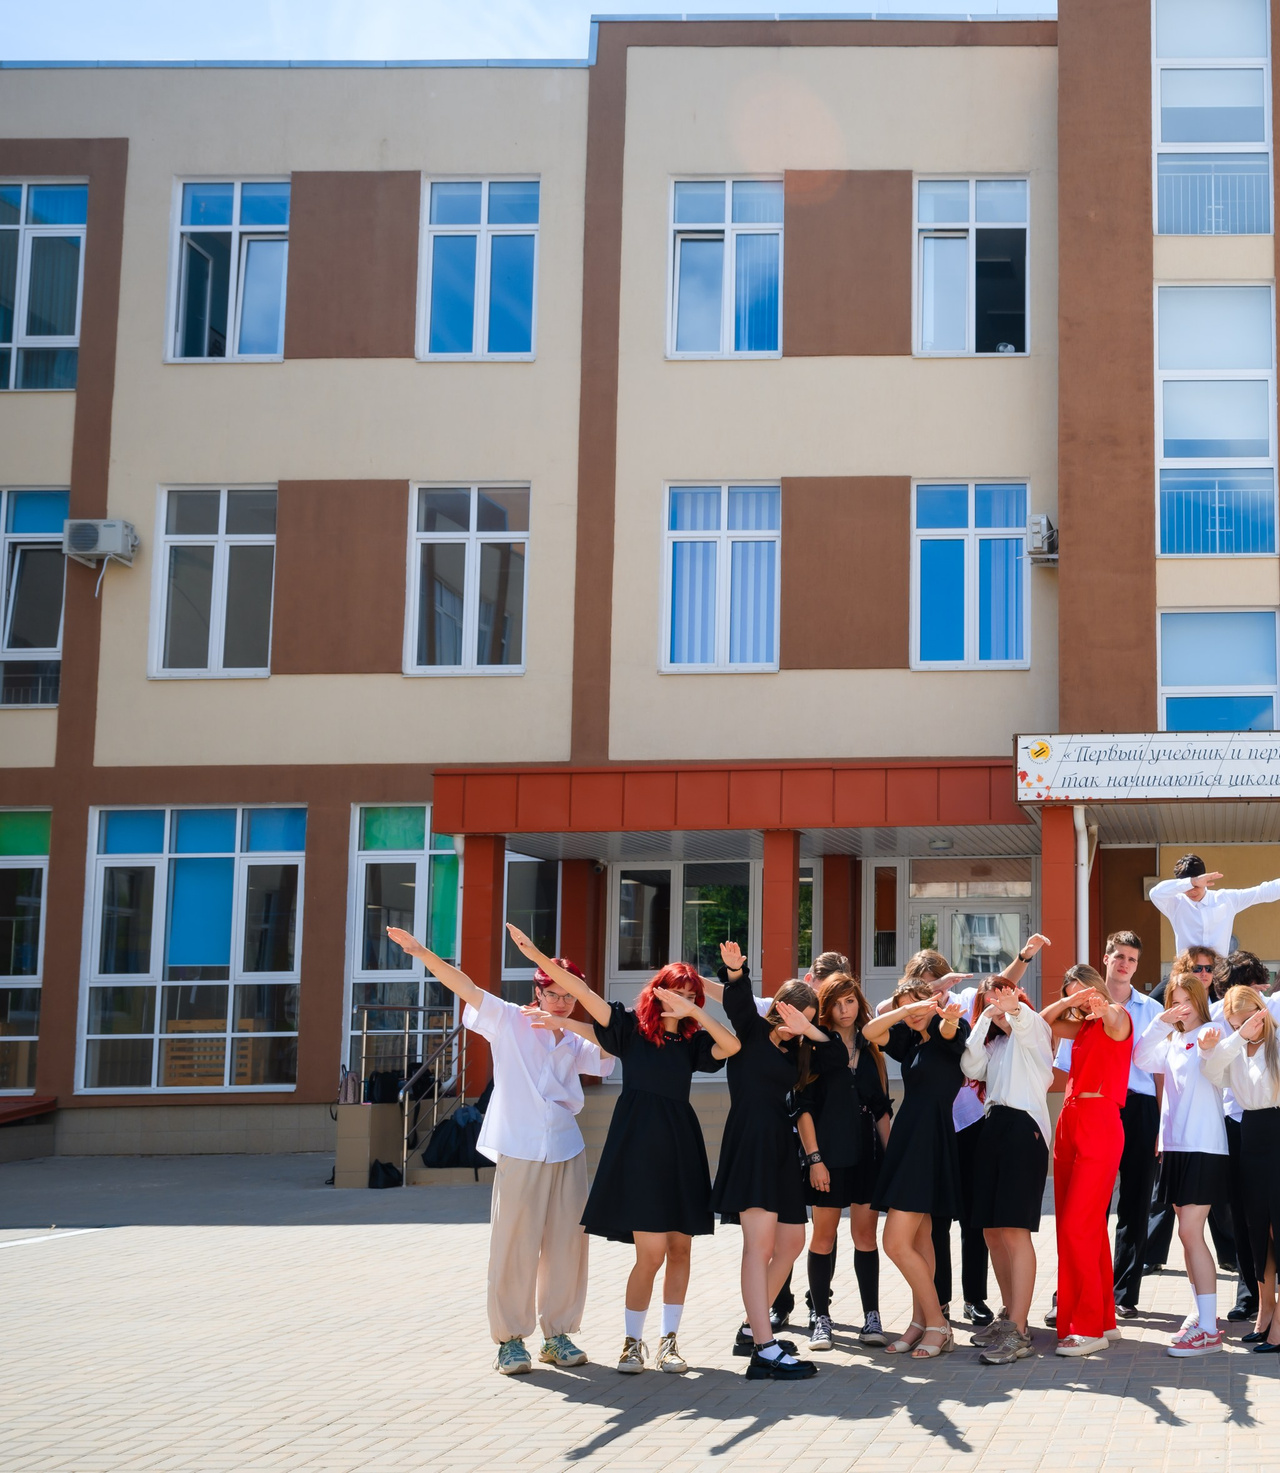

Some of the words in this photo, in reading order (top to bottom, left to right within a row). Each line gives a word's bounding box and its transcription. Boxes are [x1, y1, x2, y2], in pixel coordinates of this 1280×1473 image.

[1148, 742, 1224, 765] учебник
[1231, 748, 1243, 760] и
[1061, 772, 1101, 788] так
[1107, 770, 1223, 787] начинаются
